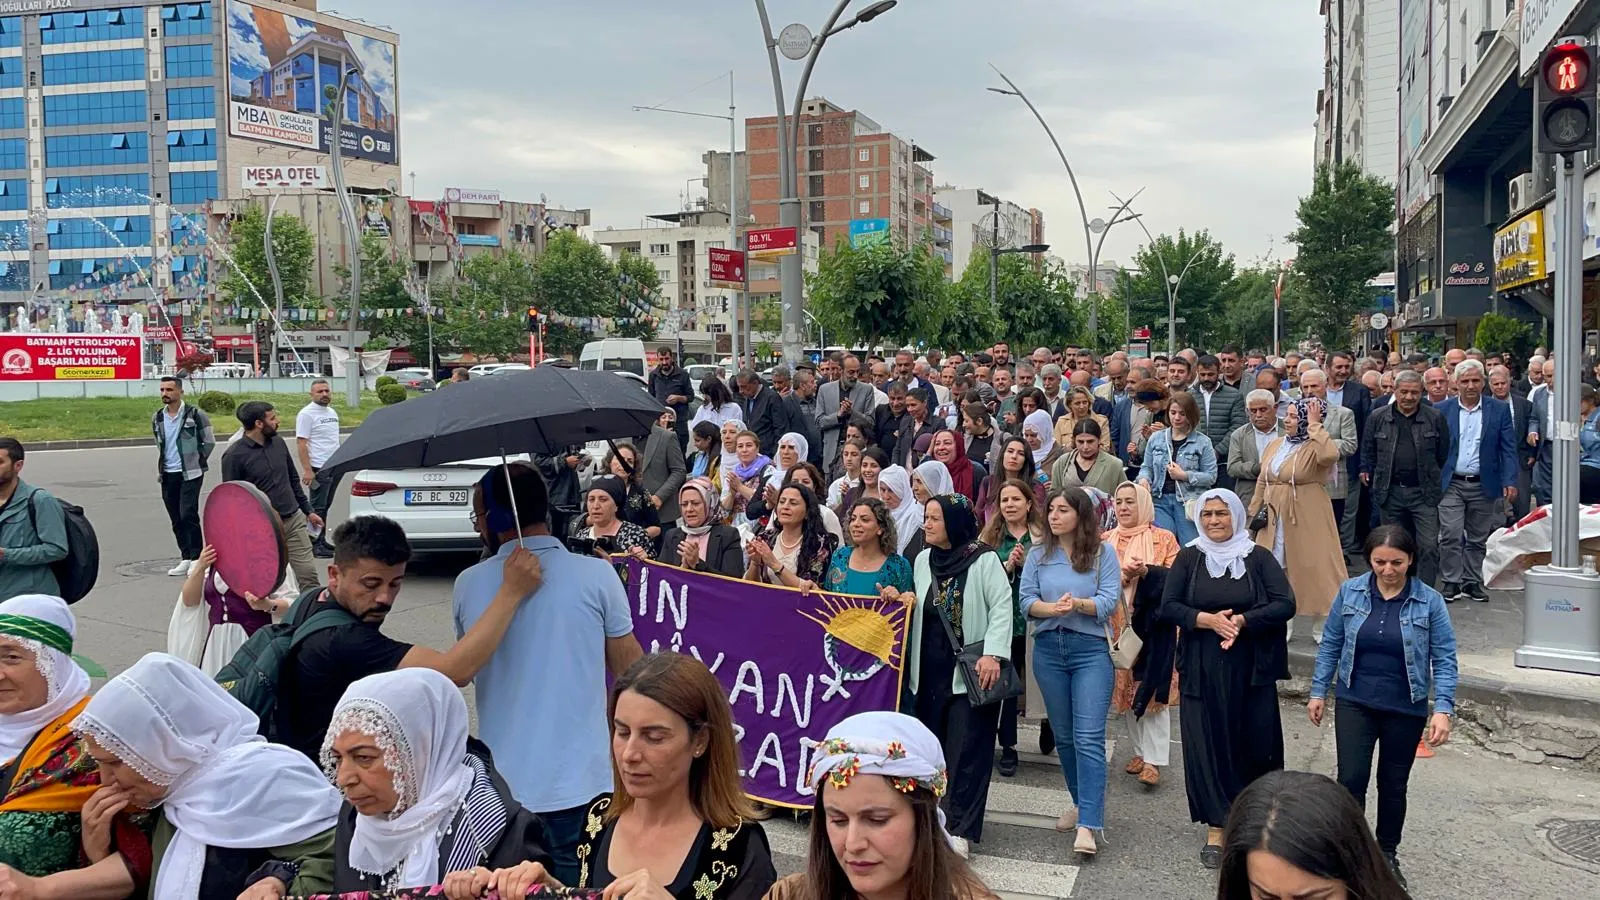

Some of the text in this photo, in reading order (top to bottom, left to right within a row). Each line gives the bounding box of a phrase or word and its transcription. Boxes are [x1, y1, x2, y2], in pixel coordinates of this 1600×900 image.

[237, 105, 270, 126] MBA
[280, 114, 313, 127] OKULLARI
[239, 123, 273, 136] BATMAN
[274, 129, 312, 143] KAMPÜSÜ
[280, 121, 313, 134] SCHOOLS
[247, 167, 321, 181] MESA OTEL
[461, 192, 499, 201] DEM PARTİ
[749, 233, 772, 243] 80. YIL
[711, 252, 731, 262] TURGUT
[711, 262, 725, 273] ÖZAL
[1449, 263, 1470, 274] Cafe
[27, 338, 136, 347] BATMAN PETROLSPOR'A
[47, 347, 118, 356] 2. LİG YOLUNDA
[38, 357, 127, 367] BAŞARILAR DİLERİZ
[411, 491, 466, 502] 26 BC 929
[639, 566, 688, 630] IN
